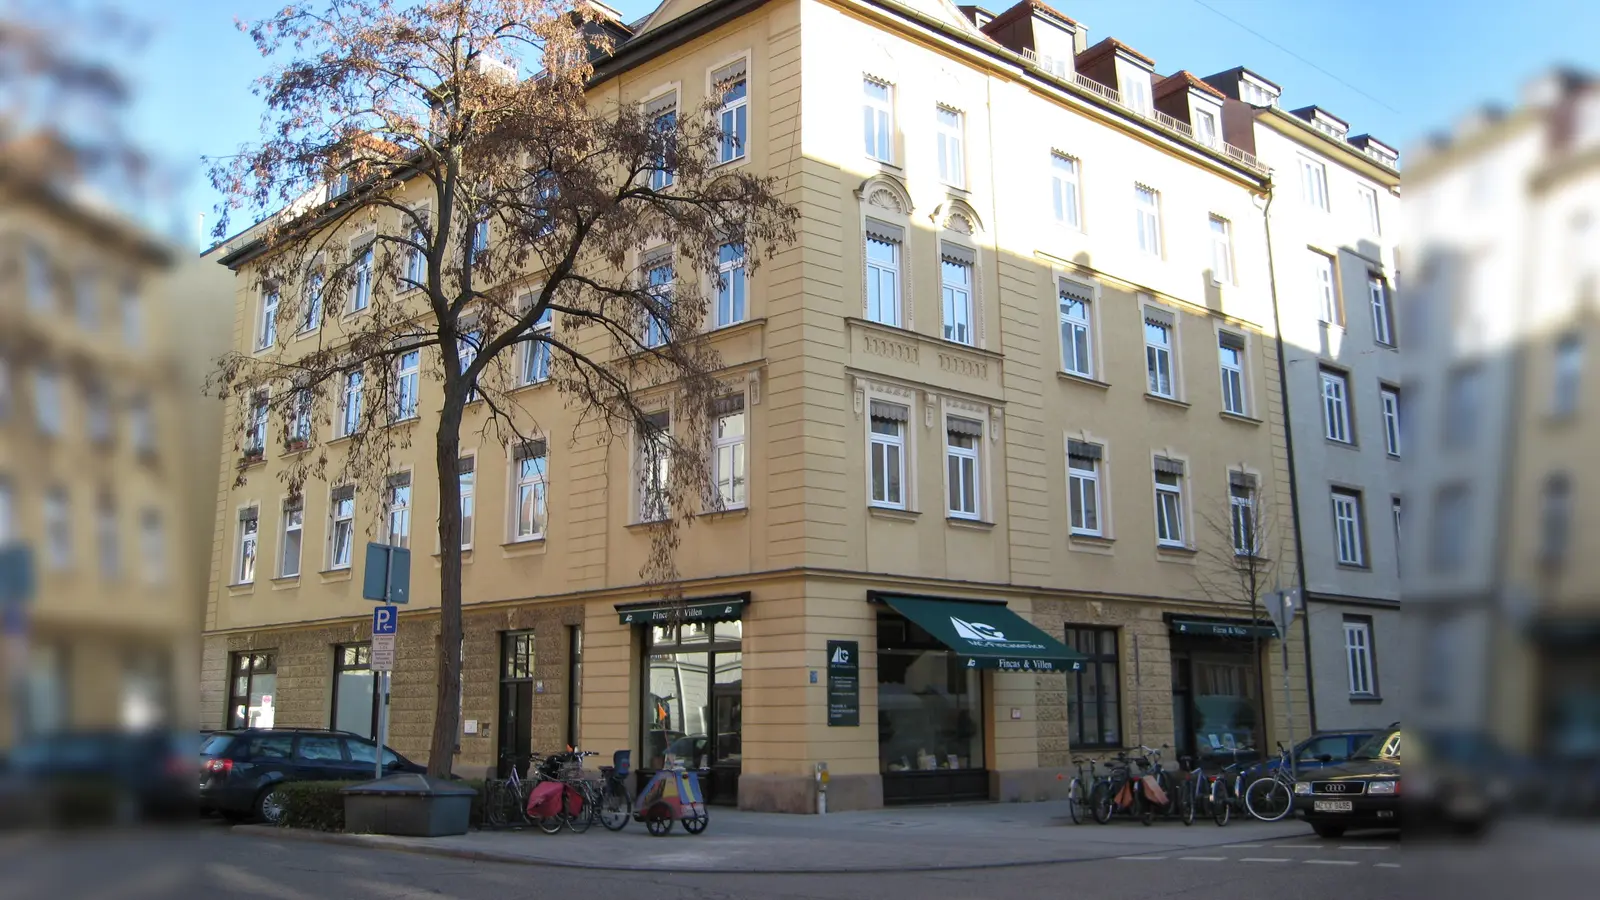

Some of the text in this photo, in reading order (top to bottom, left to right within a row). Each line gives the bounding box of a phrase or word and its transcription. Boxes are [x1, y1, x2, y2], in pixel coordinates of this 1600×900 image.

[684, 608, 703, 616] Villen
[376, 610, 390, 631] P
[998, 658, 1052, 669] Fincas & Villen
